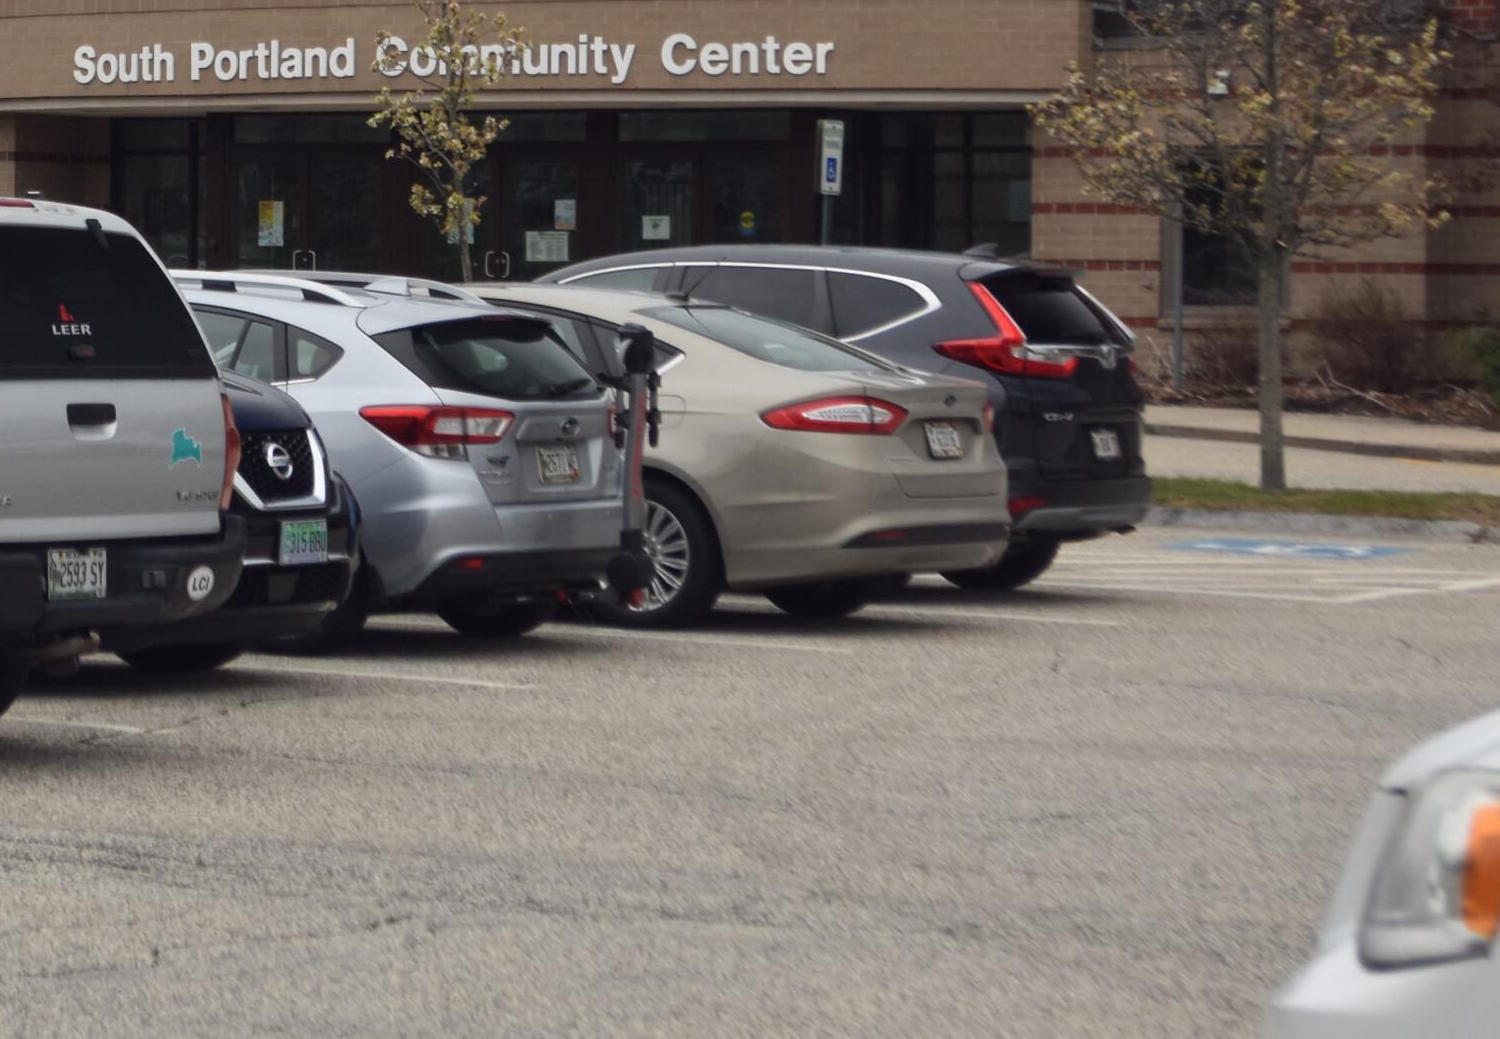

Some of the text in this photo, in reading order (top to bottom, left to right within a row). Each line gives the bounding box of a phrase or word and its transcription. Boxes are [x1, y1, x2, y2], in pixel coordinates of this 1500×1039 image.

[73, 44, 175, 84] South
[190, 38, 355, 81] Portland
[661, 33, 834, 75] Center
[52, 324, 92, 336] LEER
[59, 561, 105, 588] 2593 SY
[192, 577, 210, 592] LCI
